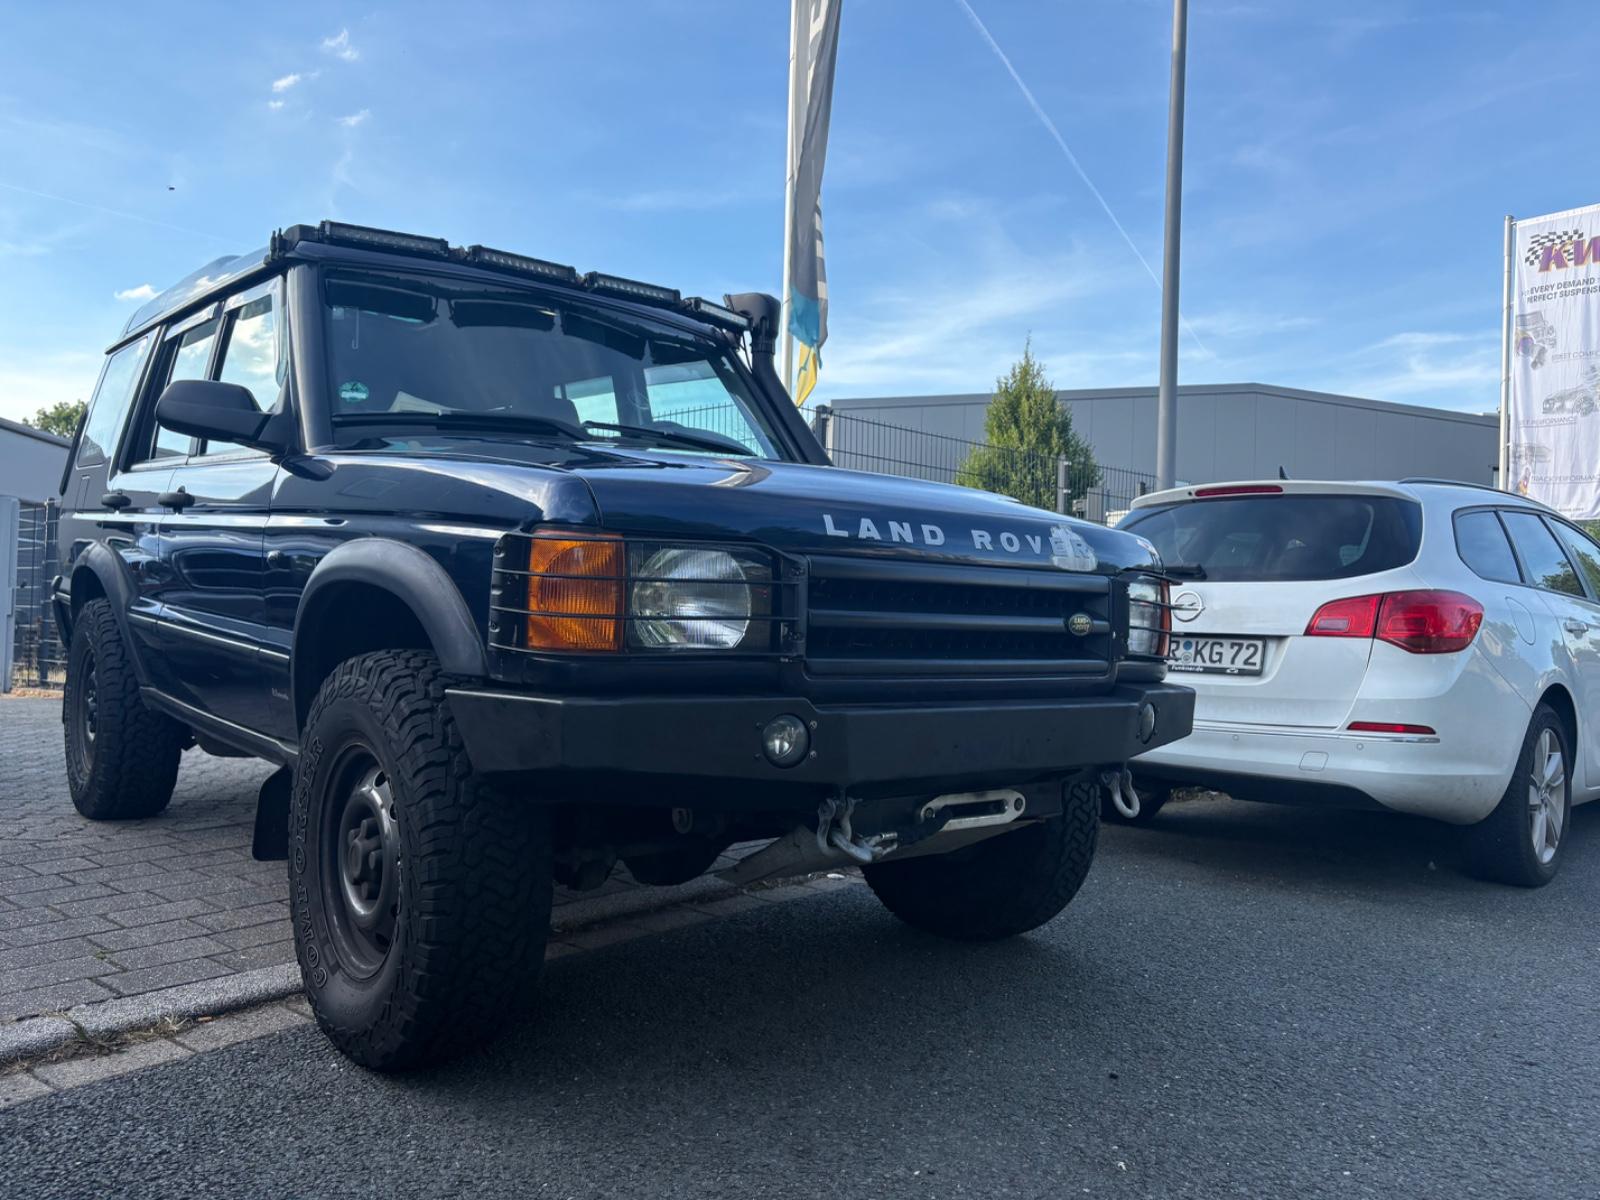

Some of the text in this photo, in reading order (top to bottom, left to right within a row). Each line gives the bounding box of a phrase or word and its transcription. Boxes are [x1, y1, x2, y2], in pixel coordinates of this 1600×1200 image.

[1530, 283, 1555, 295] EVERY
[1557, 277, 1595, 290] DEMAND
[822, 513, 946, 546] LAND
[1193, 640, 1223, 665] KG
[1229, 642, 1259, 666] 72
